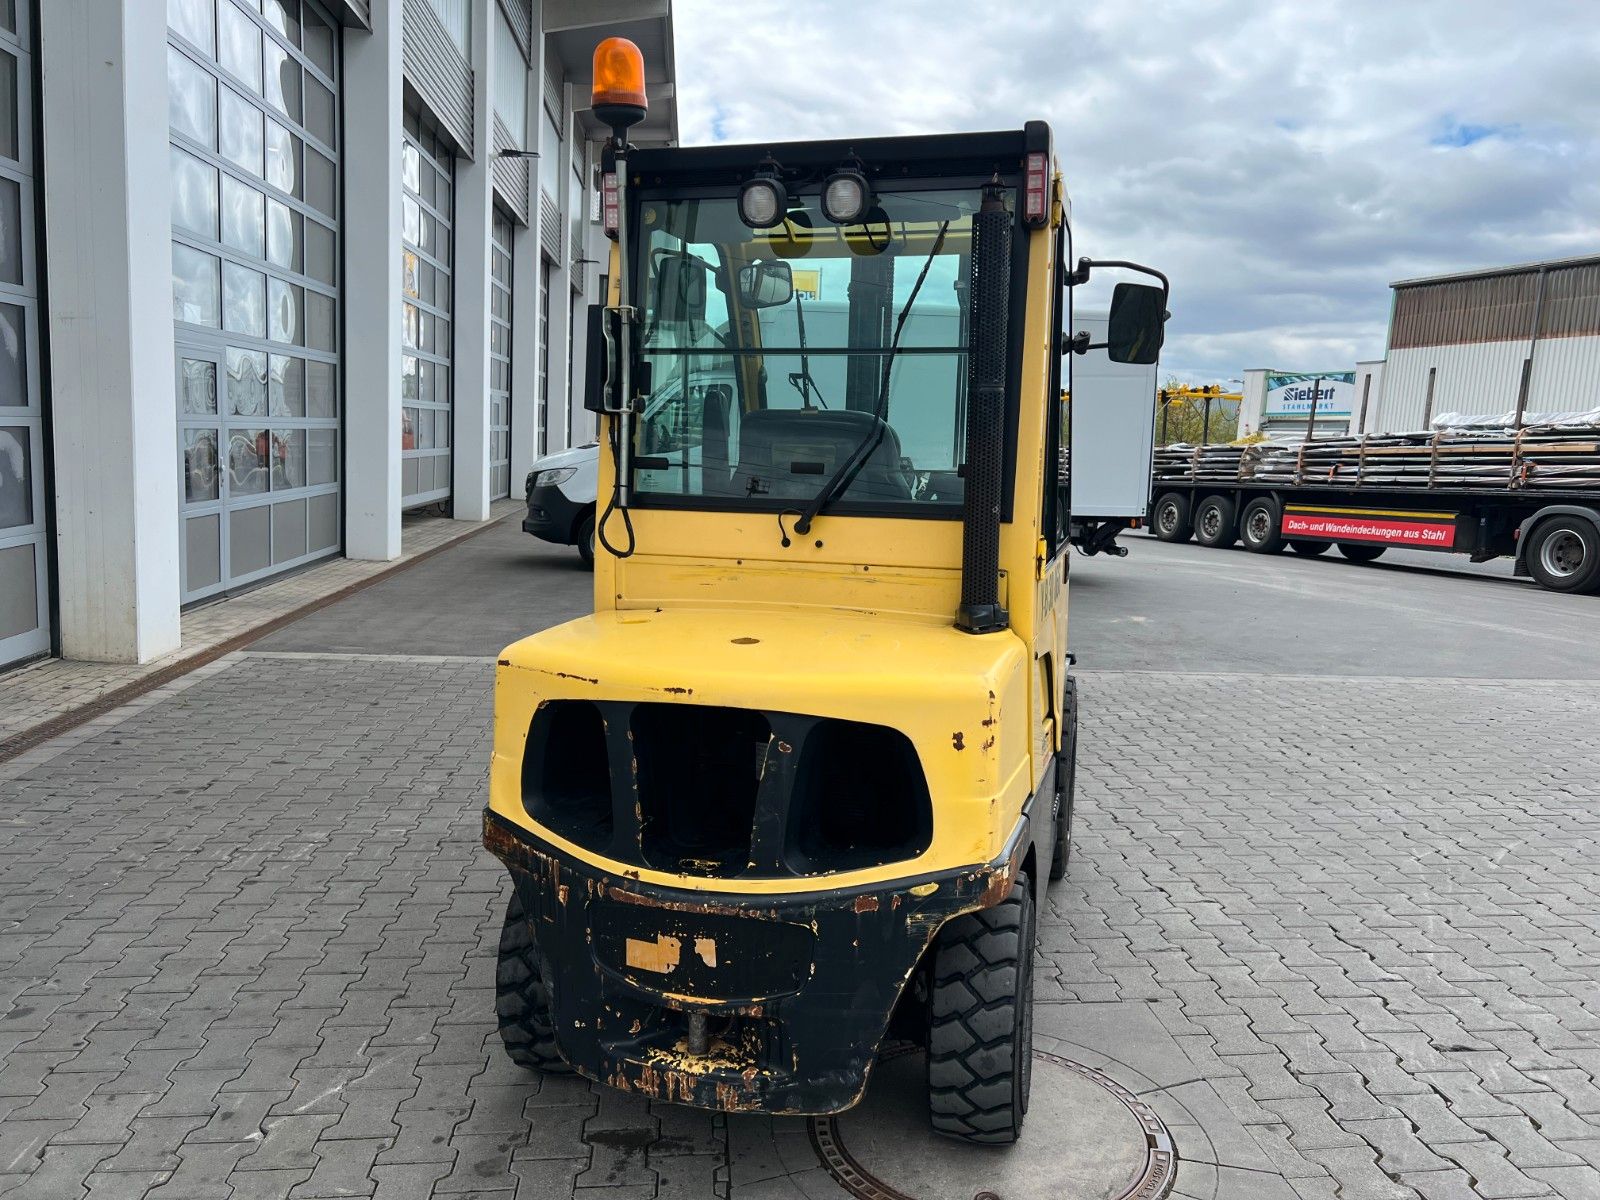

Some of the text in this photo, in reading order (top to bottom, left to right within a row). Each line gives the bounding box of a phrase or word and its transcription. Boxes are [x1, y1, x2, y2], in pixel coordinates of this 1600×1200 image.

[1284, 387, 1335, 401] Siebert
[1288, 520, 1446, 541] Dach- und Wandeindeckungen aus Stahl
